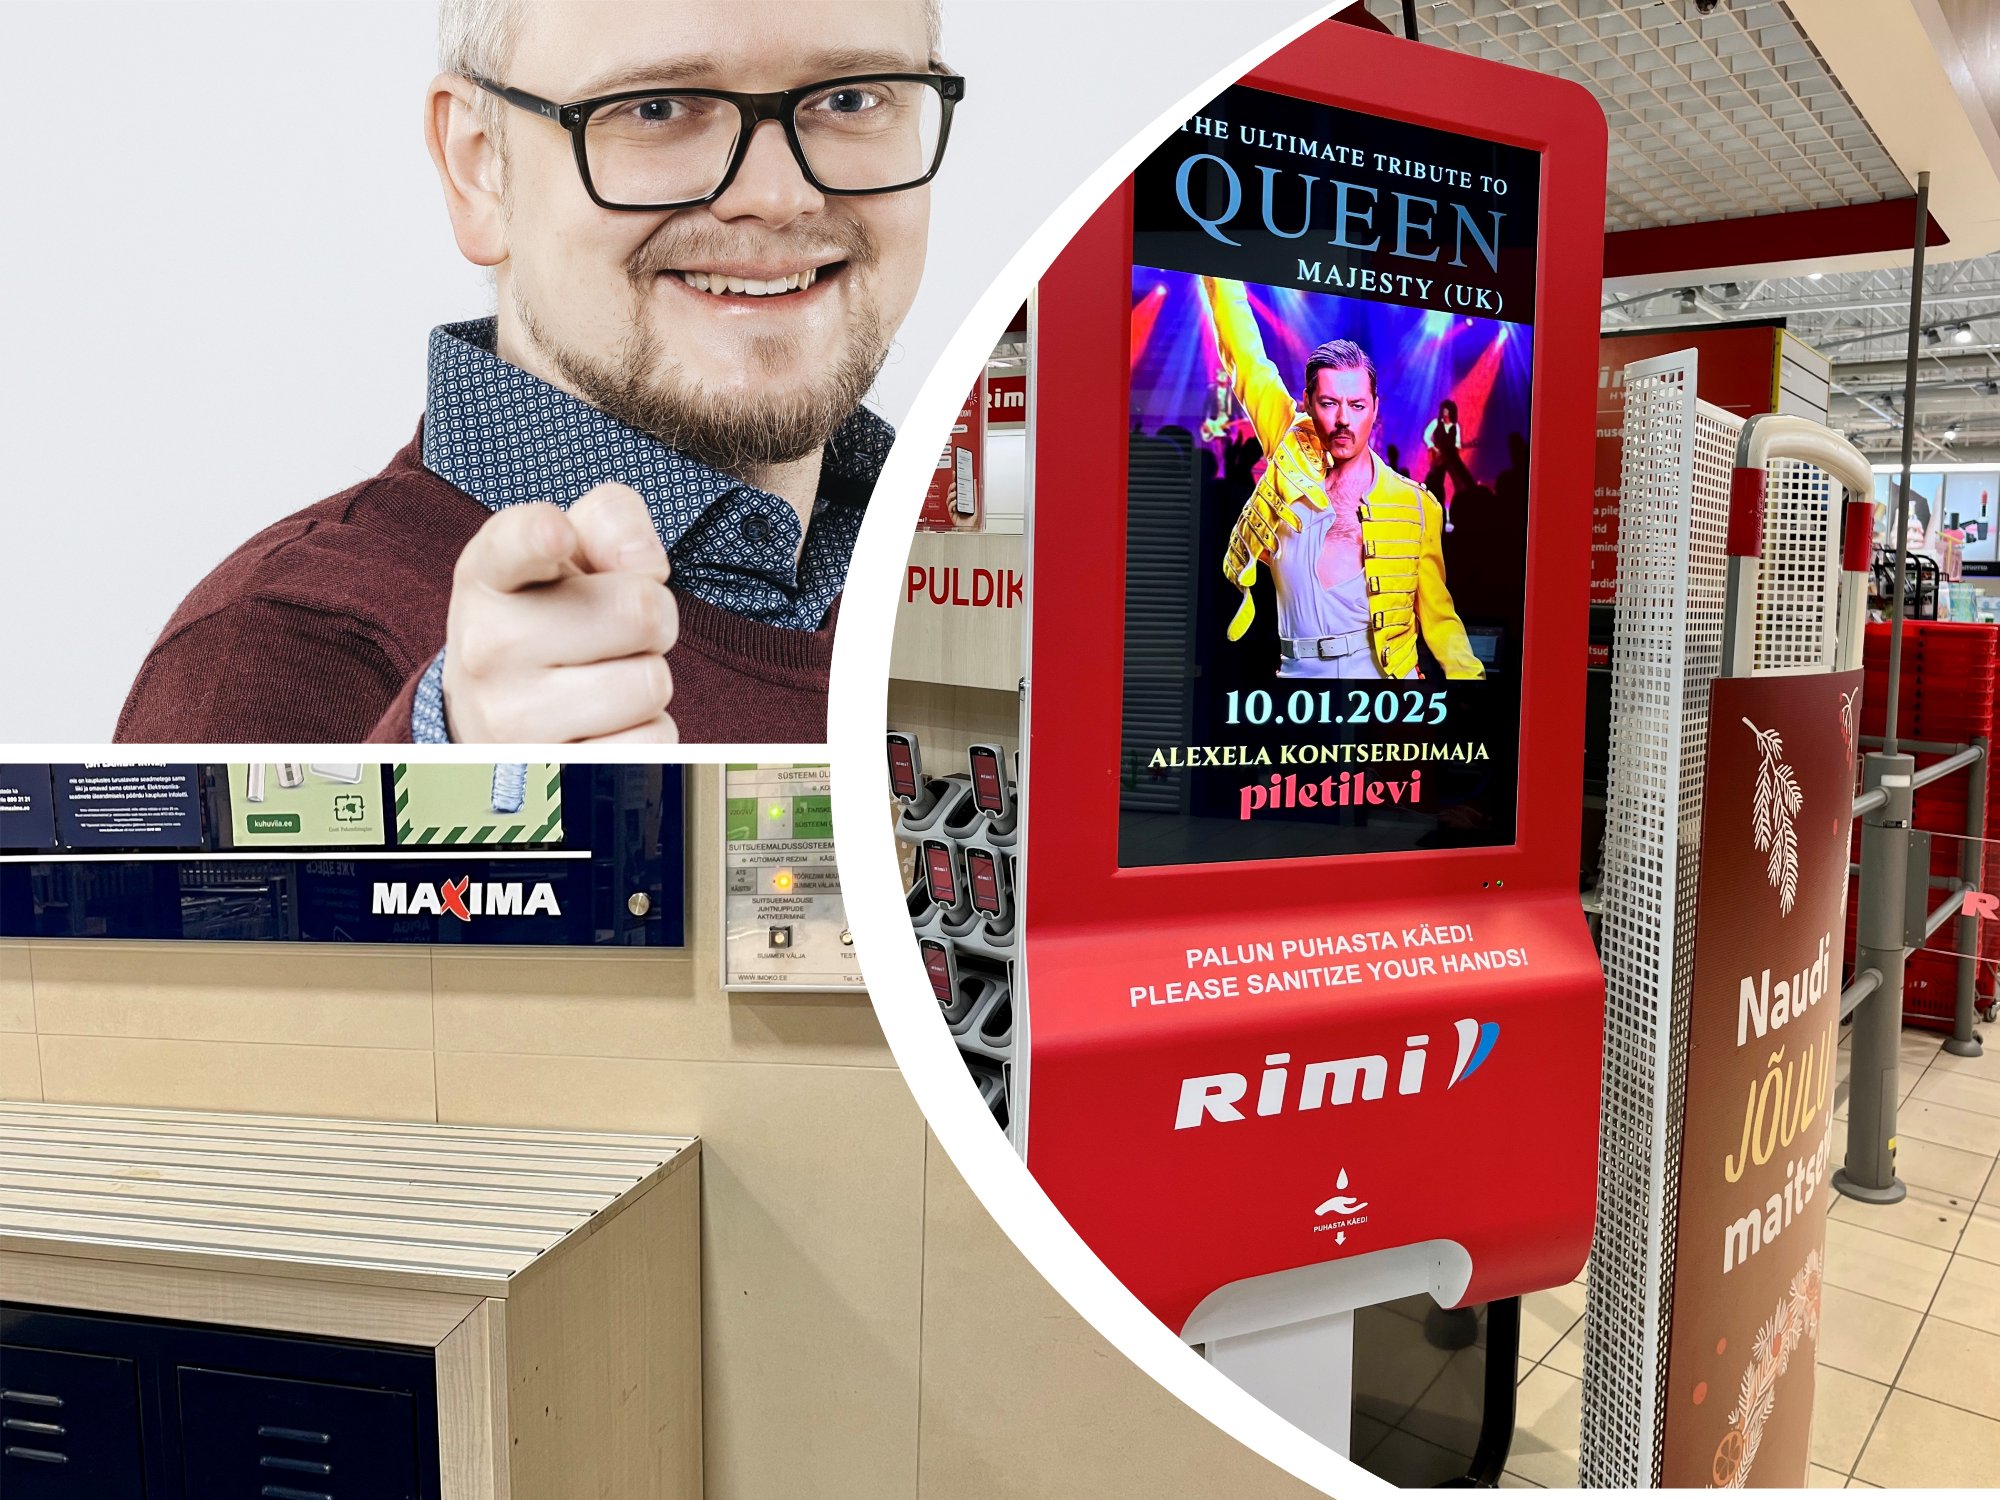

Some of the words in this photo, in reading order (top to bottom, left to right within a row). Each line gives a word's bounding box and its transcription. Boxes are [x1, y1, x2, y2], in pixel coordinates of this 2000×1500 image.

[1181, 115, 1229, 140] THE
[1240, 125, 1365, 167] ULTIMATE
[1373, 154, 1472, 189] TRIBUTE
[1480, 176, 1508, 196] TO
[1175, 153, 1507, 274] QUEEN
[1297, 258, 1434, 301] MAJESTY
[1444, 284, 1504, 314] (UK)
[1226, 690, 1448, 725] 10.01.2025
[1147, 745, 1273, 768] ALEXELA
[1279, 741, 1490, 765] KONTSERDIMAJA
[1239, 769, 1422, 821] piletilevi
[371, 875, 562, 921] MAXIMA
[1185, 941, 1275, 969] PALUN
[1283, 931, 1399, 960] PUHASTA
[1401, 923, 1475, 949] KÄED!
[1129, 976, 1240, 1008] PLEASE
[1247, 964, 1362, 994] SANITIZE
[1366, 957, 1437, 982] YOUR
[1441, 947, 1529, 973] HANDS!
[1737, 931, 1830, 1047] Naudi
[1174, 1034, 1430, 1130] Rimi
[1724, 1021, 1833, 1183] JÕULU
[1313, 1220, 1345, 1233] PUHASTA
[1346, 1215, 1368, 1226] KÄED!
